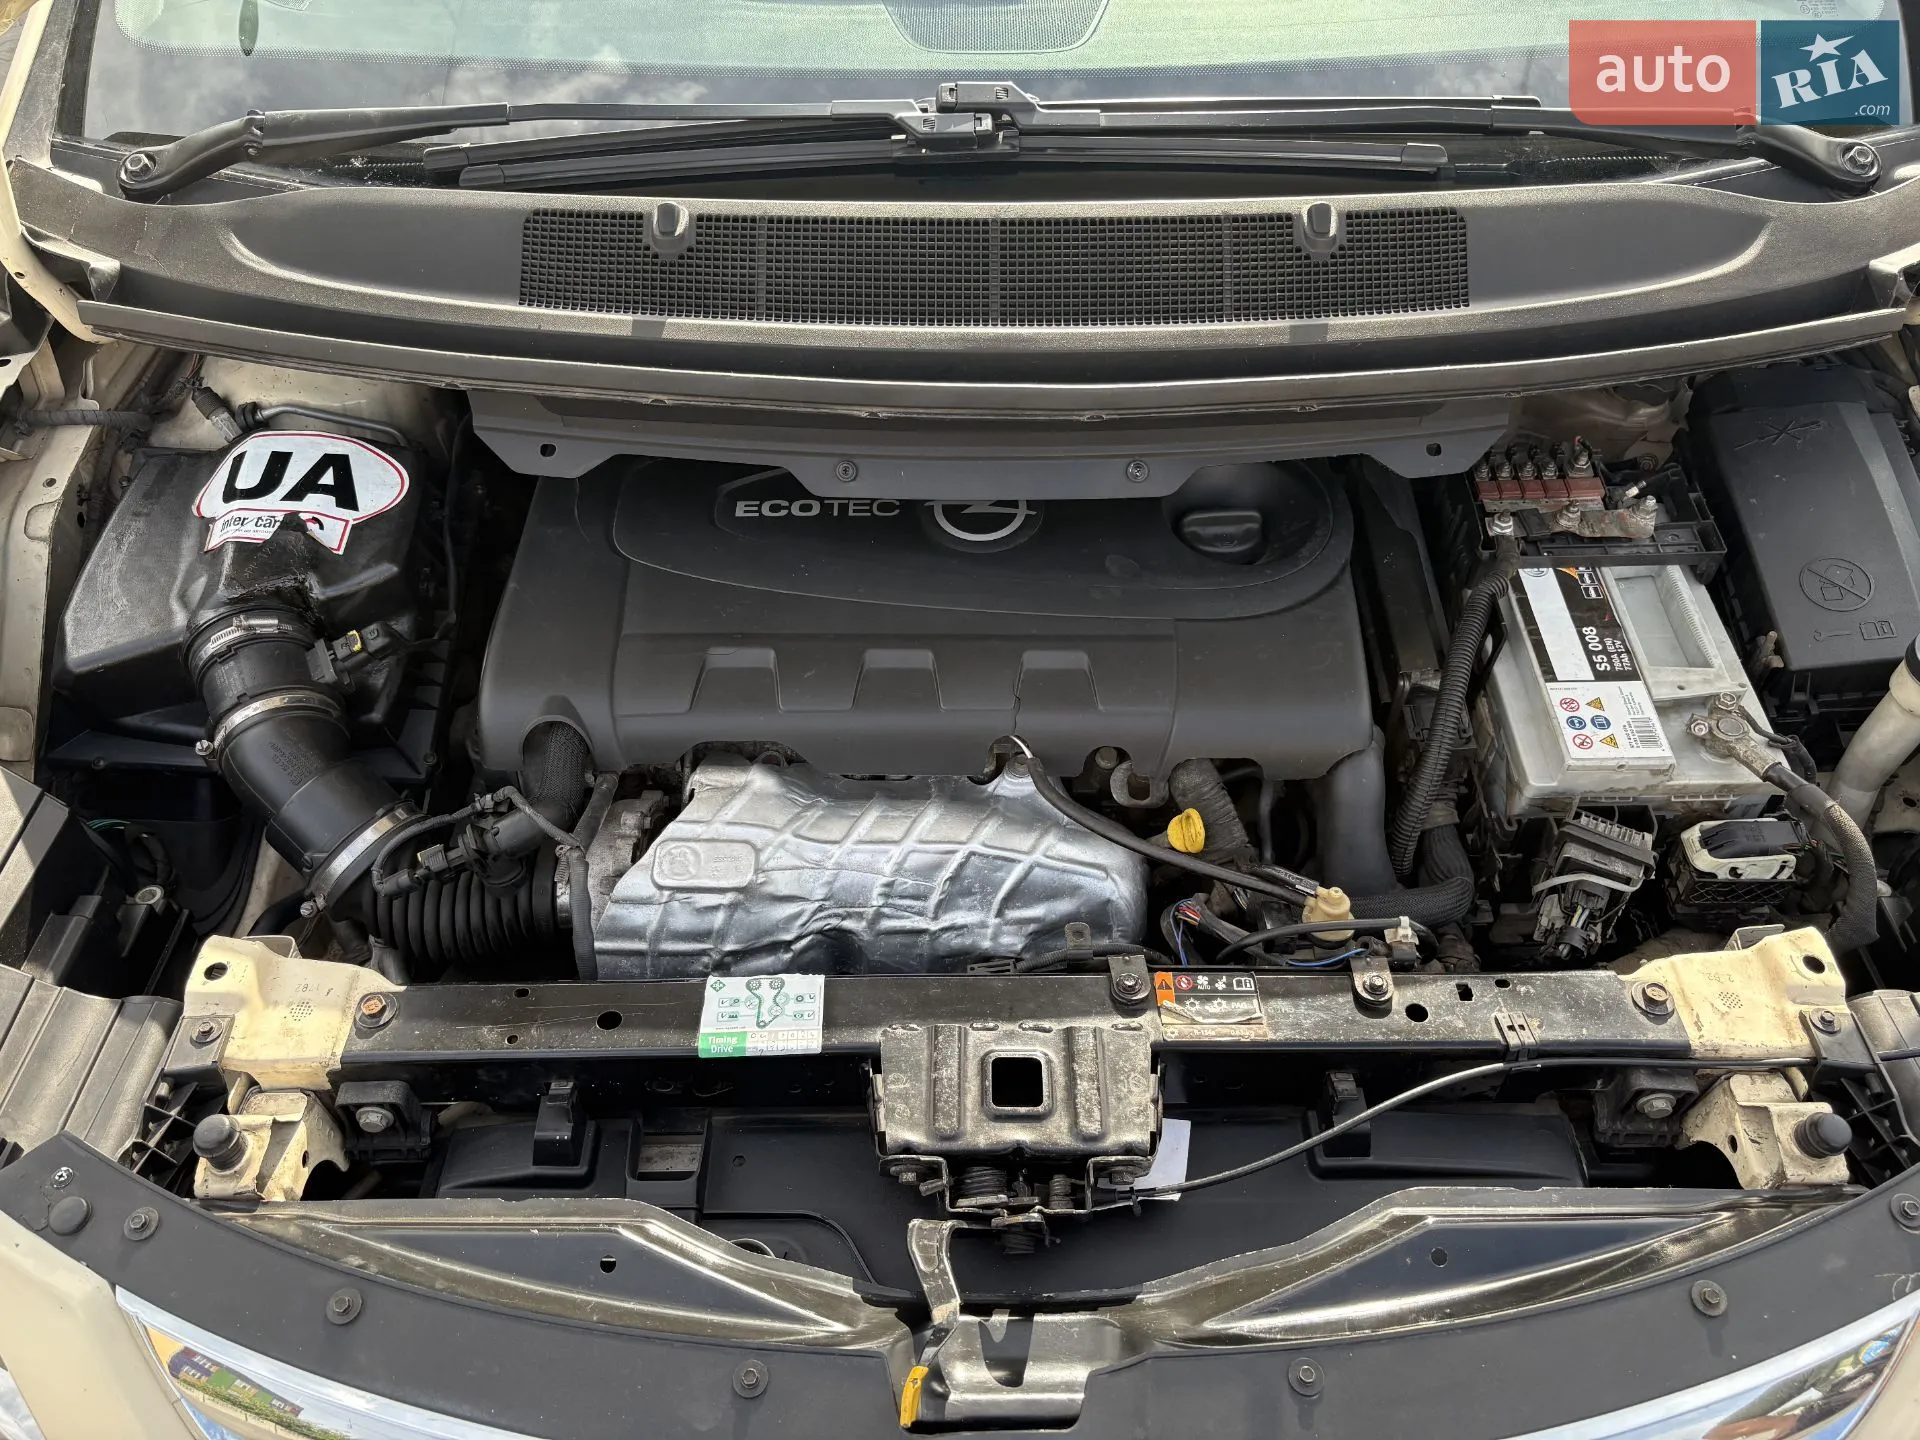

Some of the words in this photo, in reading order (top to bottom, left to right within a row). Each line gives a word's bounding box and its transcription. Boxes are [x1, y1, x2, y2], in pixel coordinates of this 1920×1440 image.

[222, 450, 360, 512] UA
[735, 499, 901, 517] ECOTEC
[220, 515, 249, 532] inter
[1582, 626, 1603, 651] 008
[1604, 638, 1616, 653] (EN)
[1613, 639, 1625, 653] 12V
[1593, 654, 1611, 671] S5
[1619, 653, 1632, 671] 77Ah
[708, 1036, 738, 1046] Timing
[710, 1045, 734, 1054] Drive
